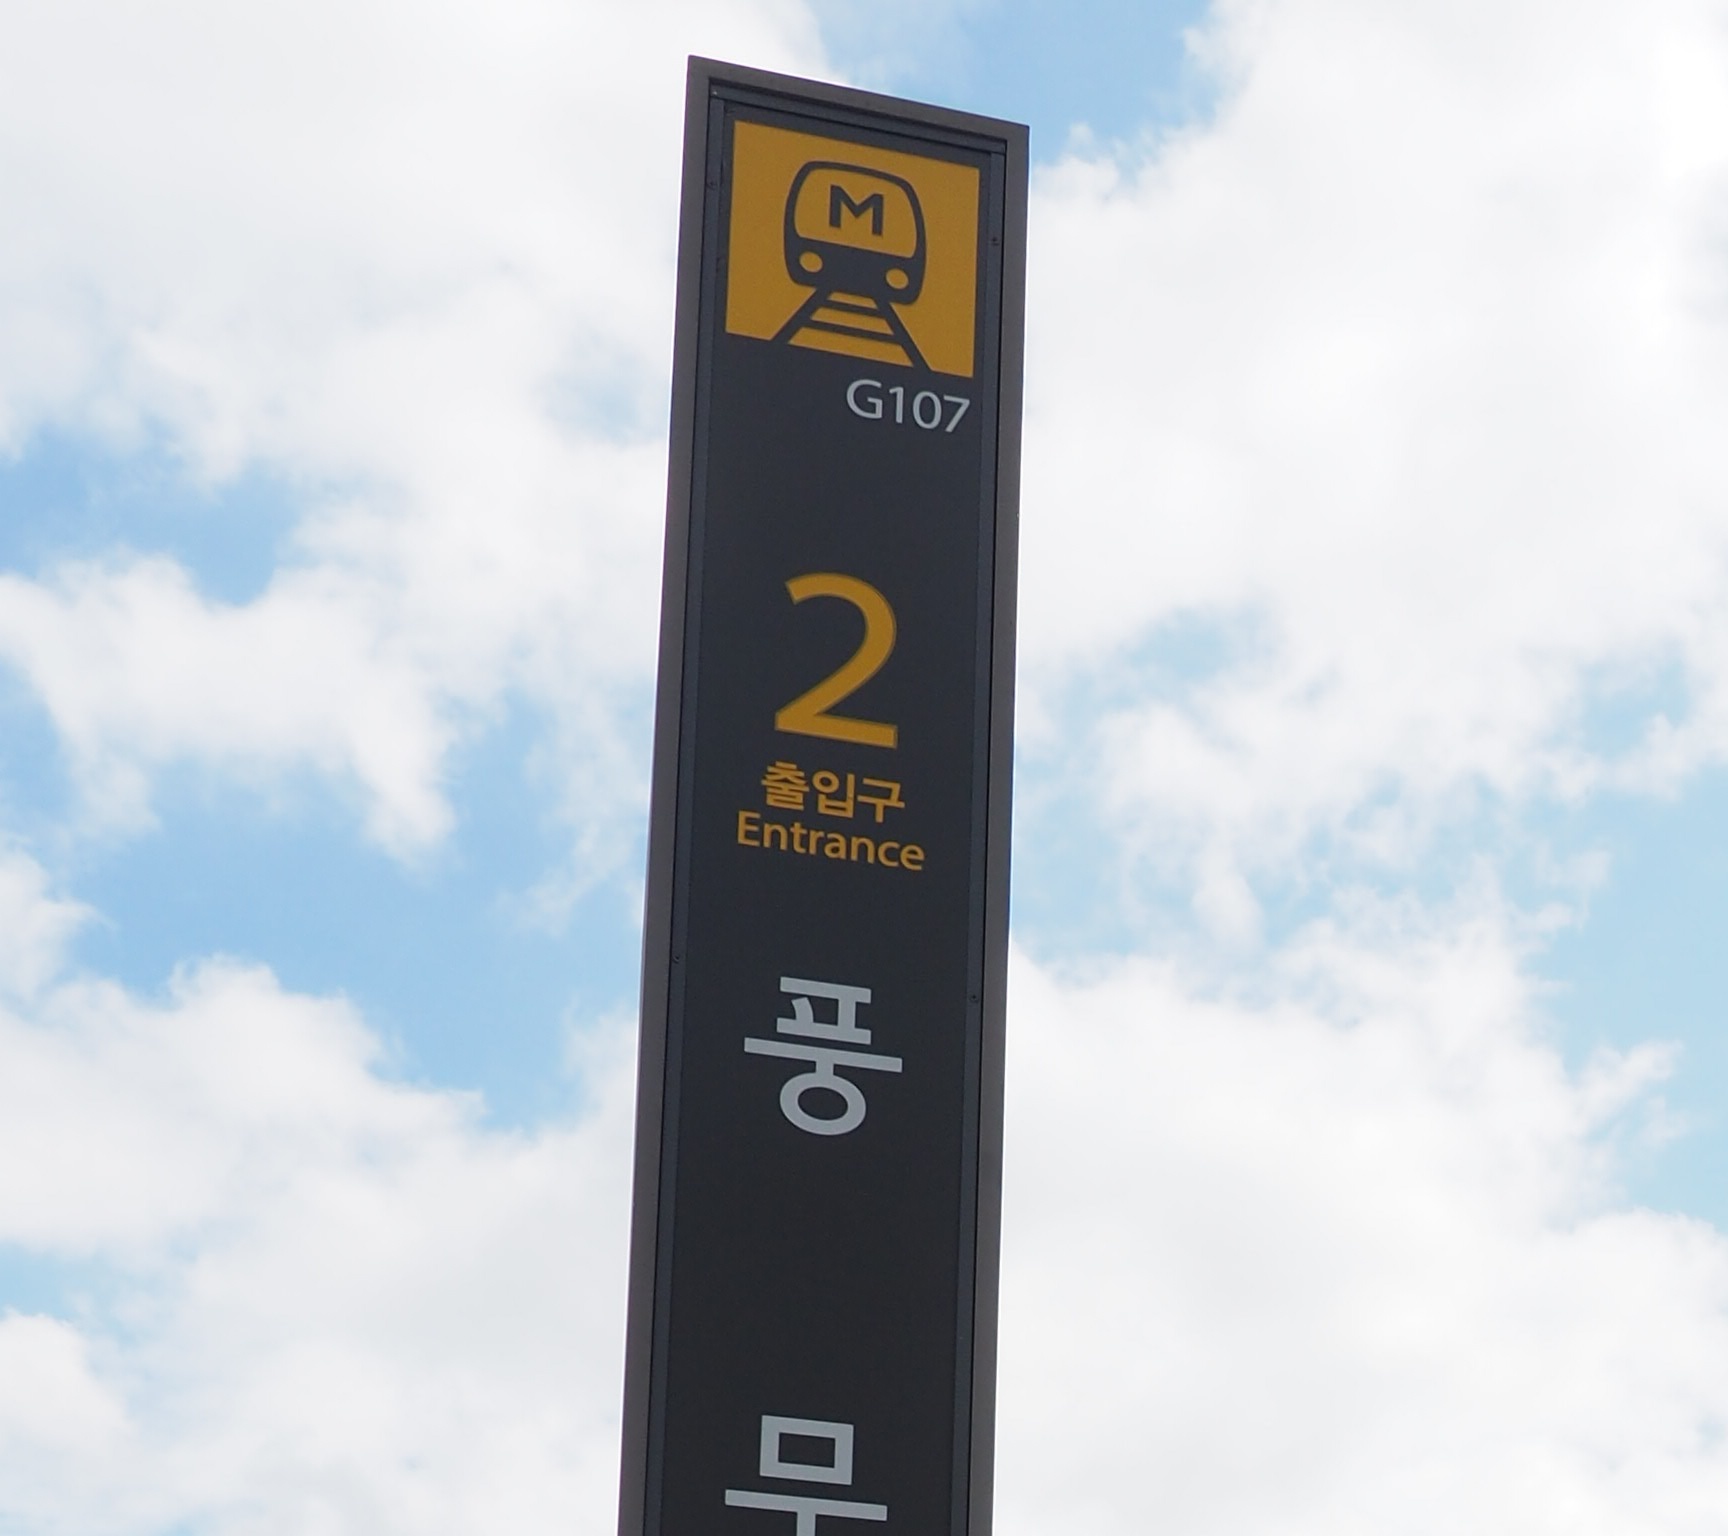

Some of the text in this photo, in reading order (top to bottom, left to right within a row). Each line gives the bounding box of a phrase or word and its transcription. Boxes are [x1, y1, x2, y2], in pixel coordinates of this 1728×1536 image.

[846, 379, 971, 434] G107
[774, 571, 899, 749] 2
[759, 760, 906, 825] 출입구
[736, 808, 926, 874] Entrance
[743, 975, 903, 1137] 풍
